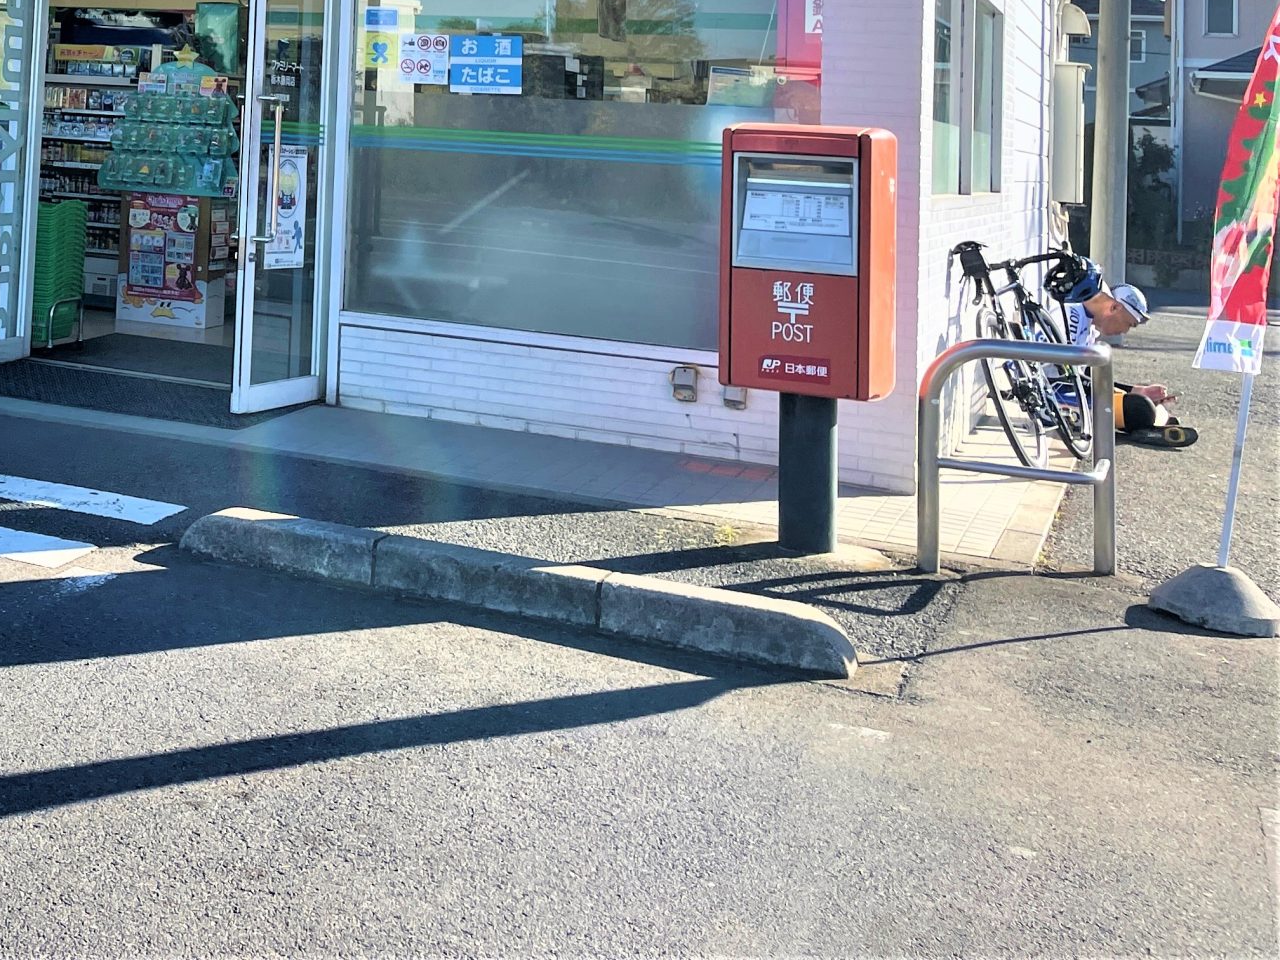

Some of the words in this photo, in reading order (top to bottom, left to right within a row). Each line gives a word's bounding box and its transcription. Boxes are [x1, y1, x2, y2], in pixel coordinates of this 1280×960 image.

[461, 38, 512, 56] お酒
[461, 67, 511, 84] たばこ
[772, 281, 814, 305] 郵便
[771, 321, 814, 343] POST
[762, 358, 781, 370] JP
[785, 362, 828, 377] 日本郵便
